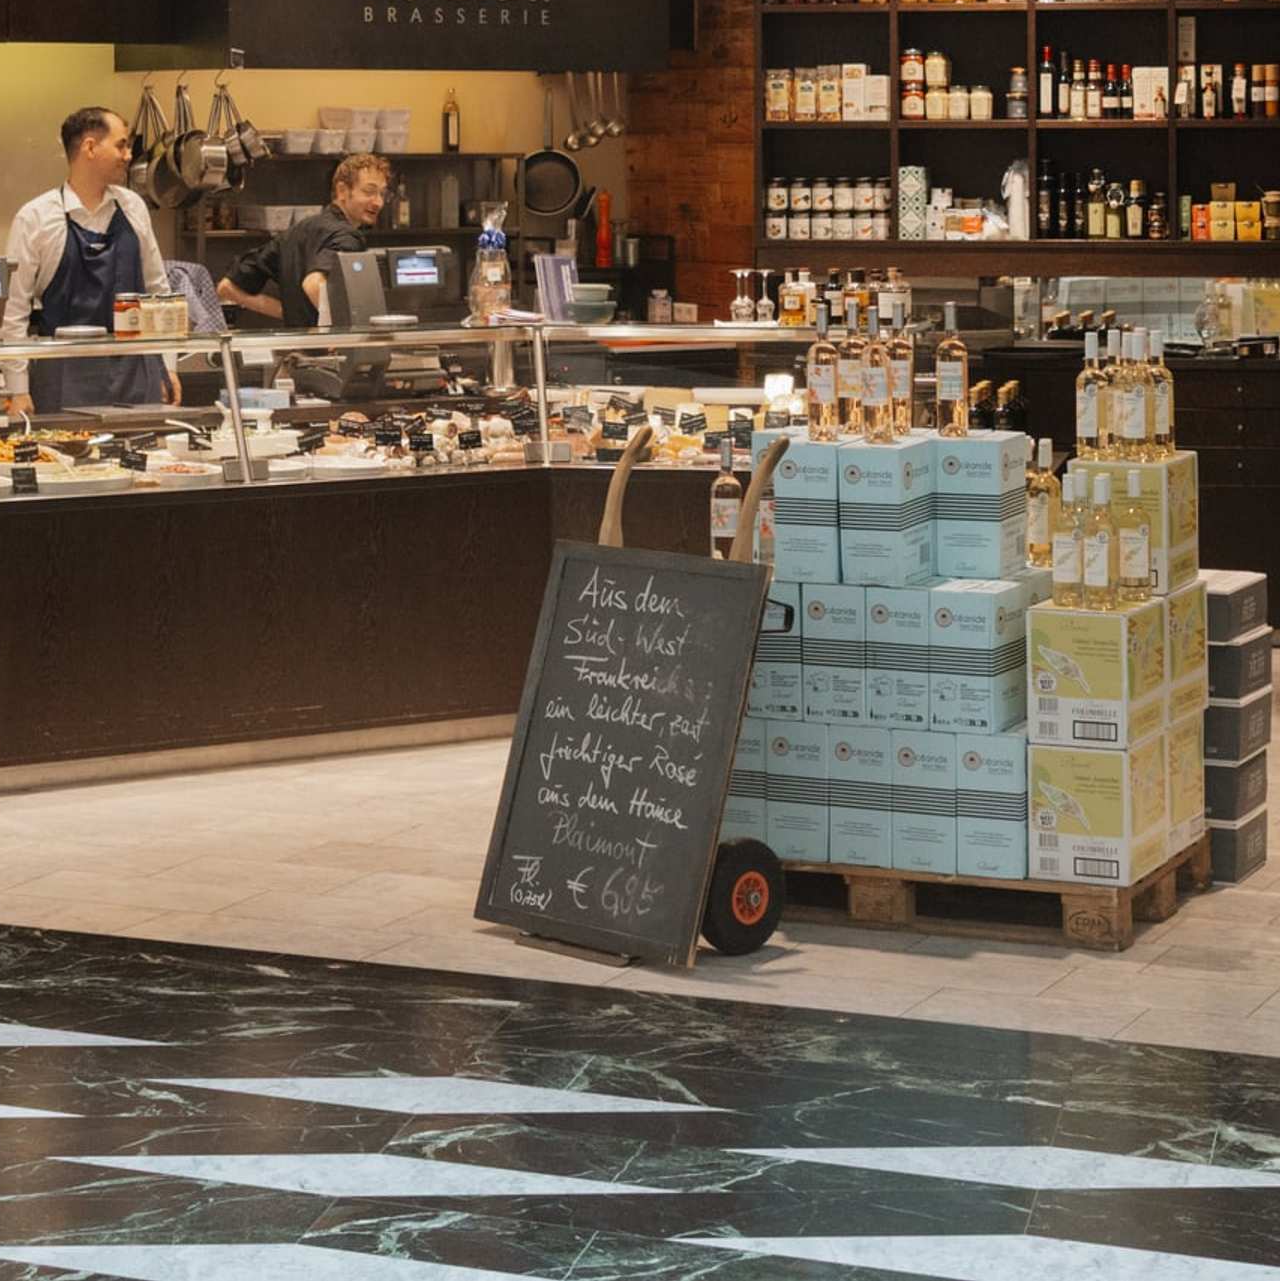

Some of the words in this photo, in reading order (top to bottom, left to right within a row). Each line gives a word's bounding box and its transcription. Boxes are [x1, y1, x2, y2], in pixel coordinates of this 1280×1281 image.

[364, 6, 552, 26] BRASSERIE
[634, 575, 687, 618] dem
[636, 622, 690, 657] West
[545, 697, 576, 721] ein
[648, 744, 704, 788] Rosé
[577, 780, 619, 816] dem
